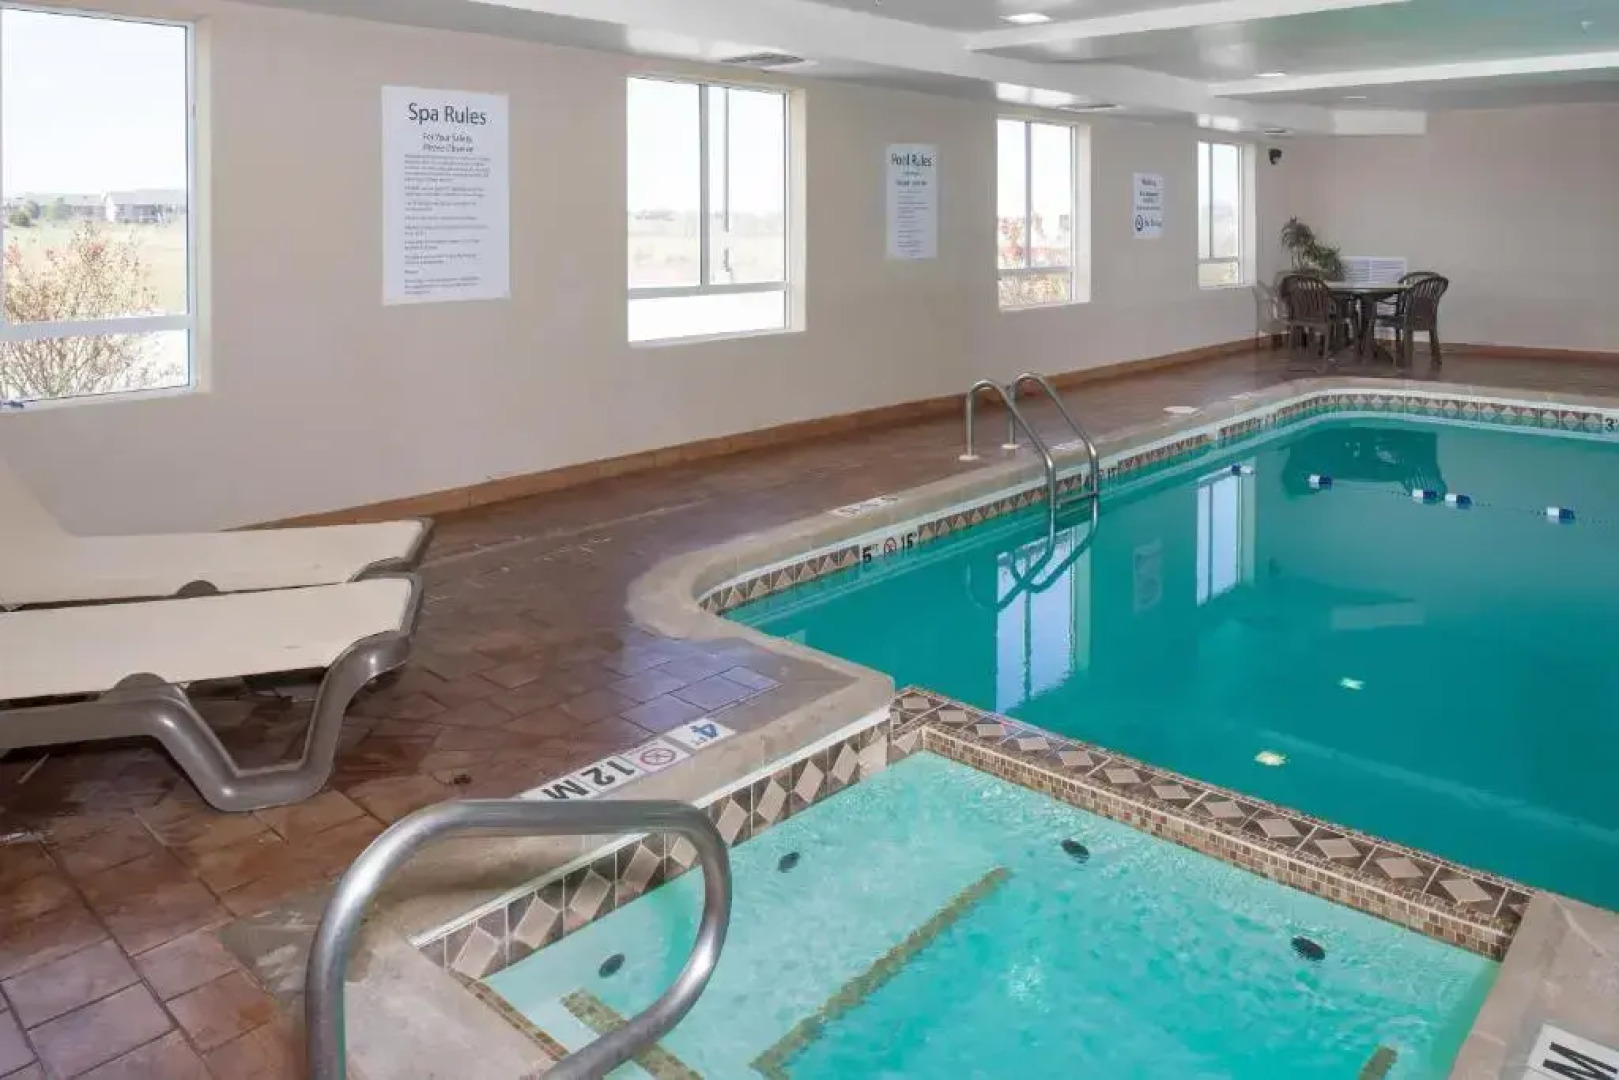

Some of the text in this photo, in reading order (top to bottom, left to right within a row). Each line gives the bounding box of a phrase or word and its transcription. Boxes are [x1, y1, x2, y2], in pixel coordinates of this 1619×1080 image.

[408, 102, 487, 125] Spa Rules
[891, 152, 932, 167] Pool Rules
